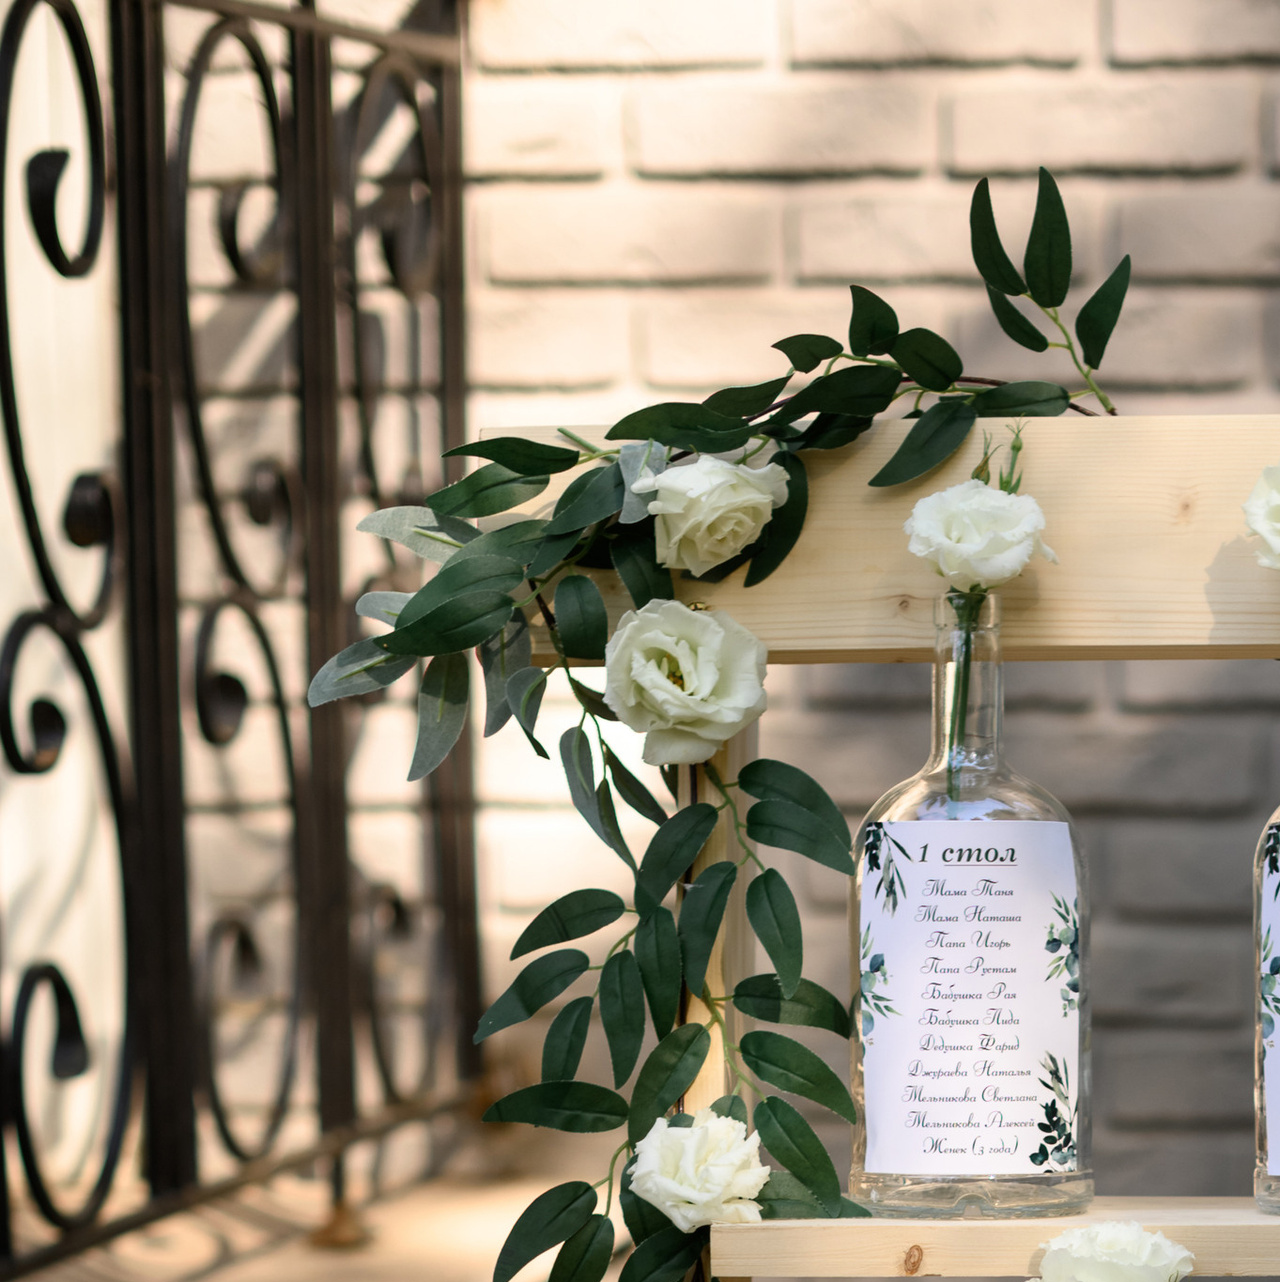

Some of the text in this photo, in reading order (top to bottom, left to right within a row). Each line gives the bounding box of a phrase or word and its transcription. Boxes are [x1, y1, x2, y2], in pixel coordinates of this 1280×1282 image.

[918, 843, 1017, 863] 1 стол
[922, 879, 1014, 896] Мама Таня
[914, 905, 1021, 922] Мама Наташа
[925, 930, 1011, 950] Папа Игорь
[920, 956, 1017, 976] Папа Рустам
[921, 982, 1016, 1002] Бабушка Рая
[918, 1008, 1020, 1028] Бабушка Лида
[919, 1034, 1020, 1053] Дедушка Фарид
[908, 1059, 1031, 1079] Джураева Наталья
[901, 1085, 1037, 1103] Мельникова Светлана
[985, 1111, 1035, 1128] Алексей
[923, 1135, 1018, 1155] Женек (3 года)
